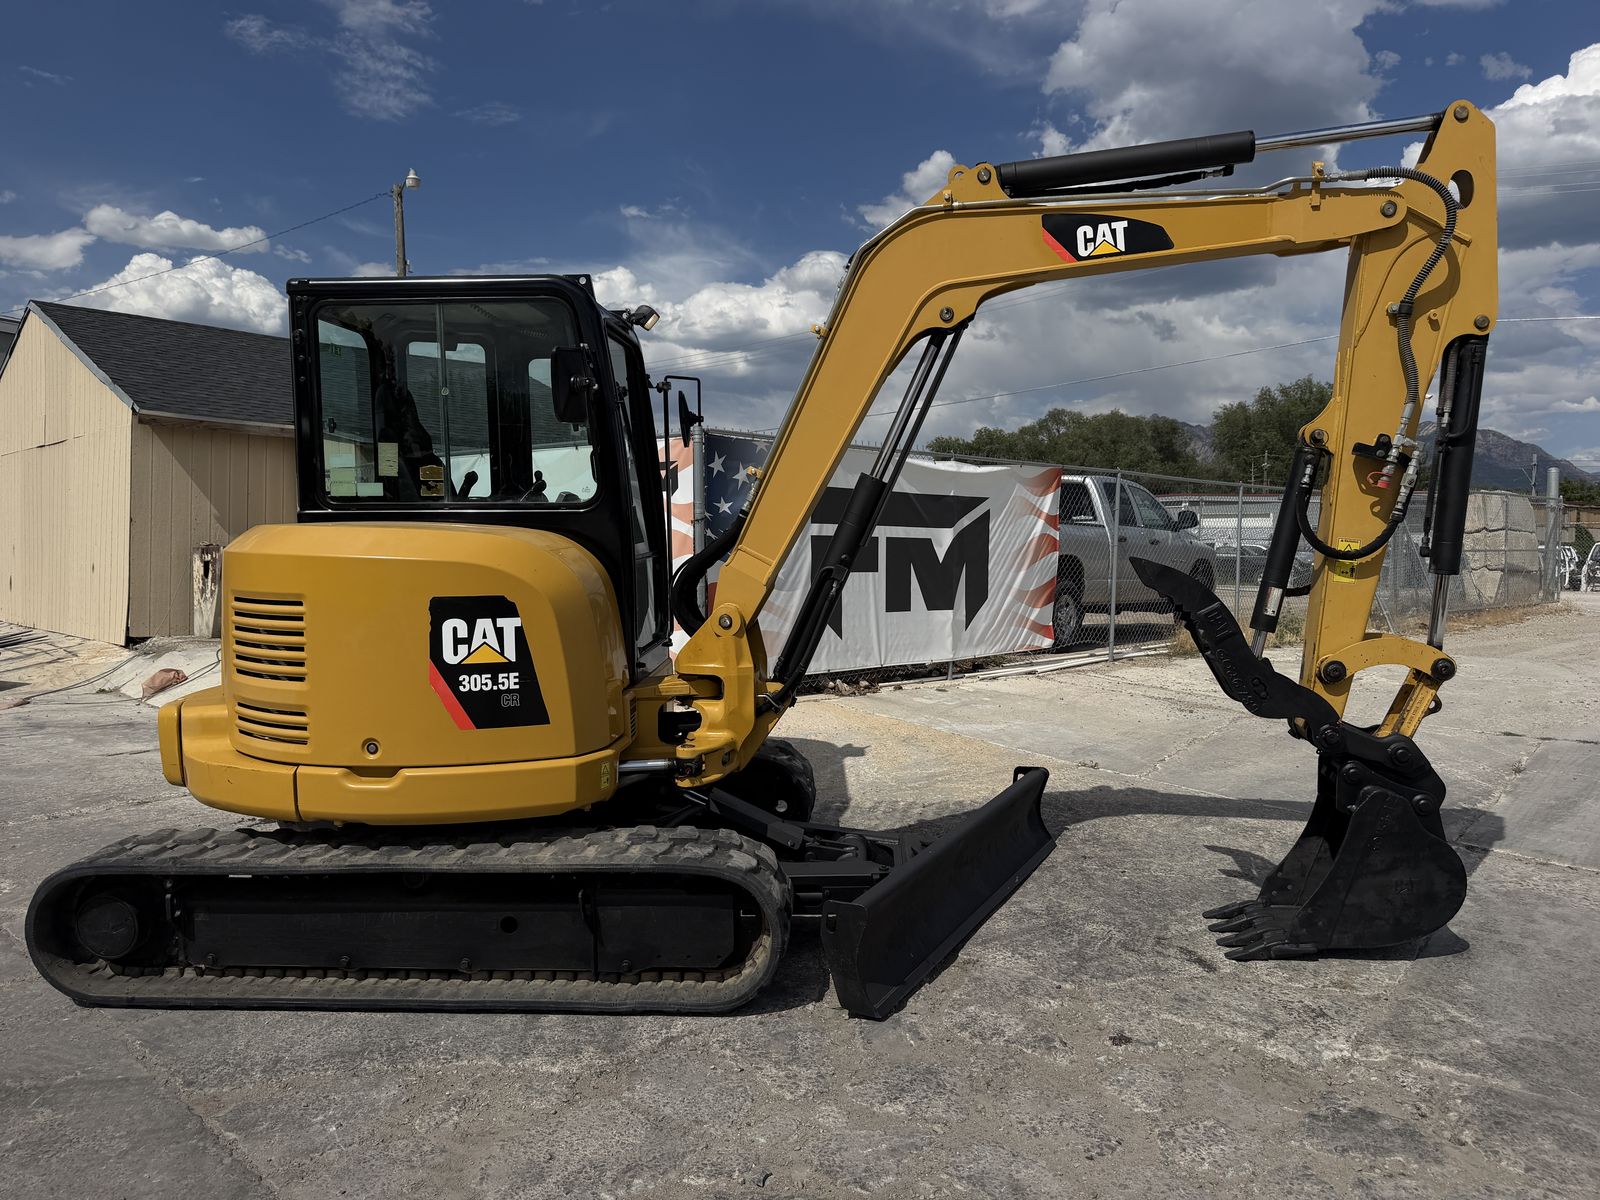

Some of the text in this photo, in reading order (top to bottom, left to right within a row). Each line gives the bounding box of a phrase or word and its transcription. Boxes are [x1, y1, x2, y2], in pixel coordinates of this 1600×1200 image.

[1076, 220, 1128, 257] CAT
[441, 617, 522, 665] CAT
[459, 672, 520, 692] 305.5E
[501, 693, 520, 708] CR
